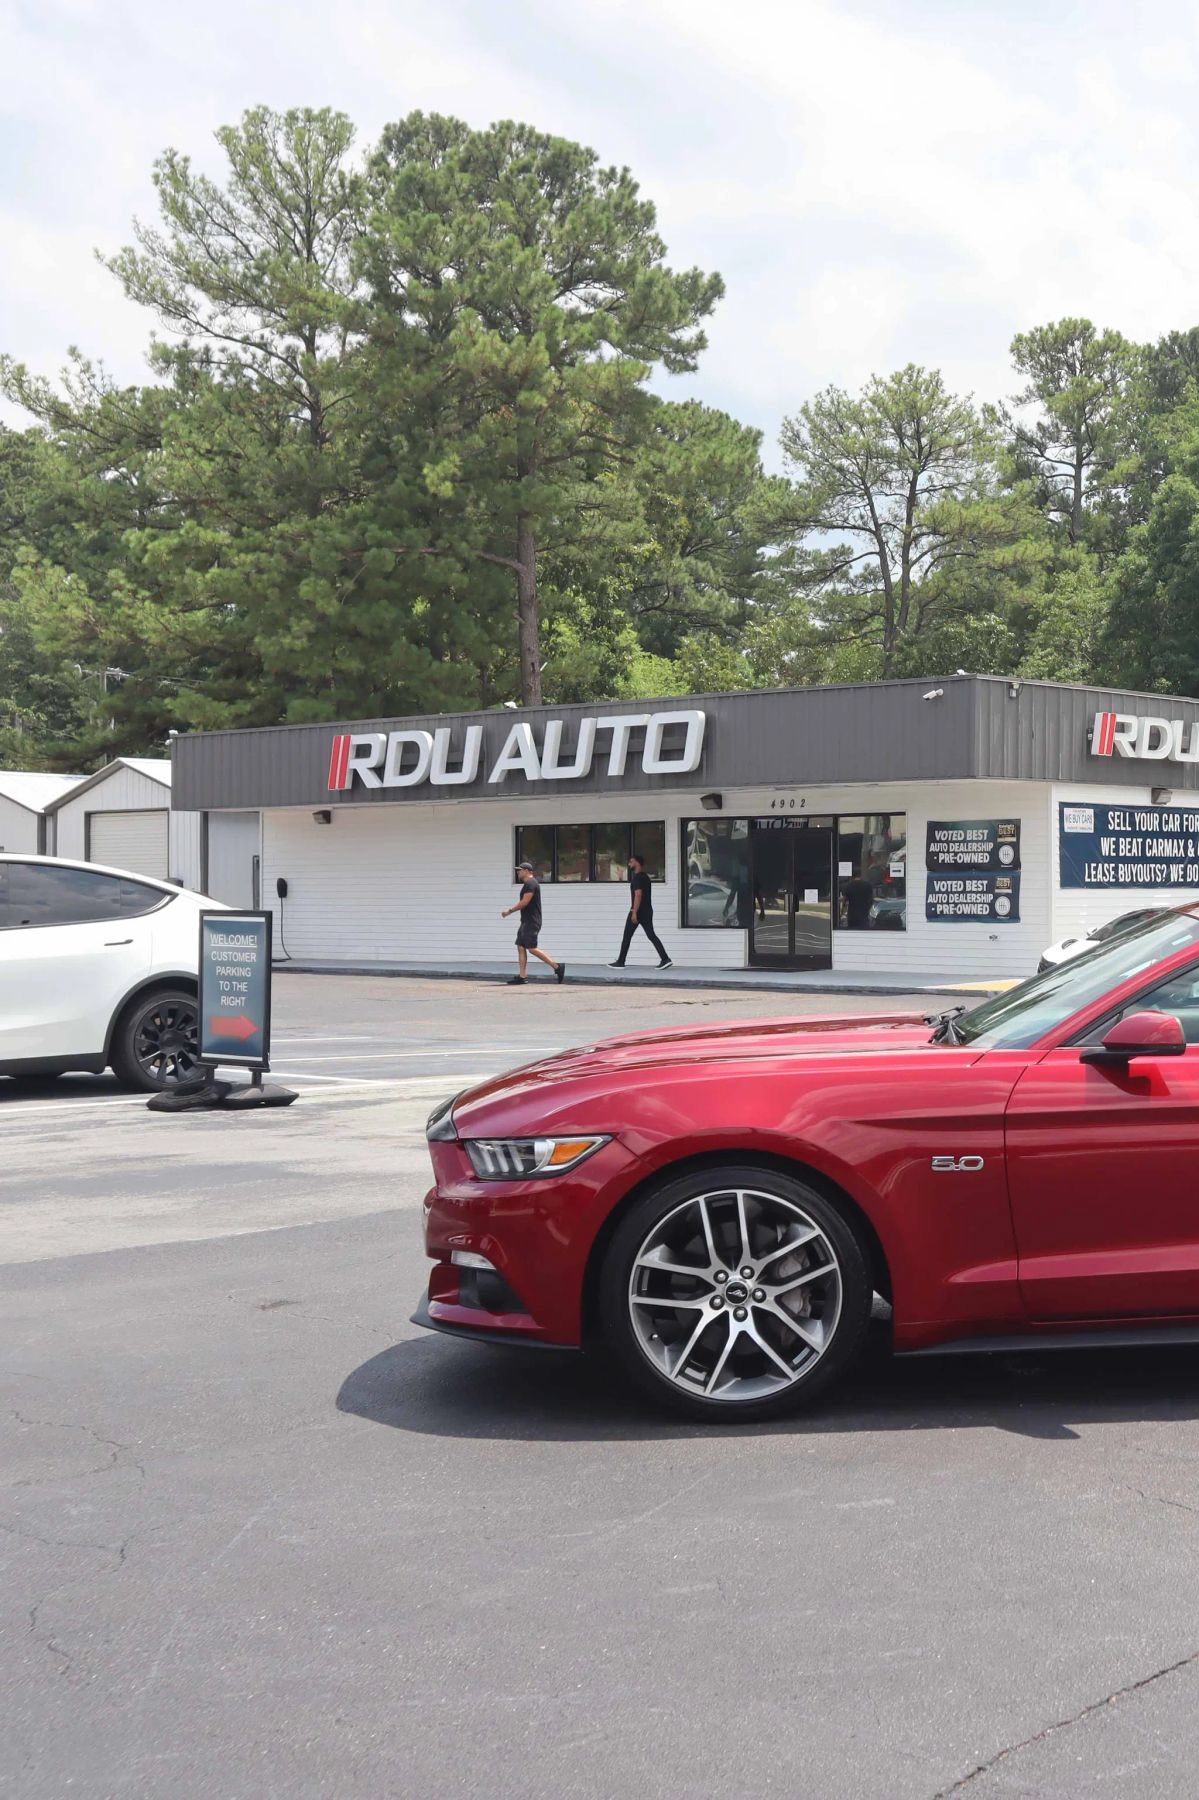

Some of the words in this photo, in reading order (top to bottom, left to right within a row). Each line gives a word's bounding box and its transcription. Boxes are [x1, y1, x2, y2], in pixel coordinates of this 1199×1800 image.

[327, 725, 483, 791] RDU
[487, 710, 706, 784] AUTO
[771, 798, 806, 809] 4902
[1107, 811, 1132, 832] SELL
[1134, 812, 1160, 832] YOUR
[1162, 813, 1181, 833] CAR
[935, 830, 964, 841] VOTED
[966, 829, 989, 840] BEST
[929, 842, 948, 852] AUTO
[949, 842, 994, 852] DEALERSHIP
[1101, 837, 1117, 857] WE
[1119, 838, 1143, 857] BEAT
[1145, 838, 1185, 858] CARMAX
[1187, 839, 1195, 858] &
[938, 852, 990, 863] PRE-OWNED
[1085, 863, 1116, 882] LEASE
[1118, 863, 1166, 882] BUYOUTS?
[1169, 864, 1184, 882] WE
[1186, 864, 1199, 882] DO
[933, 881, 964, 892] VOTED
[965, 880, 988, 892] BEST
[927, 893, 948, 903] AUTO
[949, 893, 994, 904] DEALERSHIP
[936, 904, 990, 915] PRE-OWNED
[210, 933, 257, 946] WELCOME!
[211, 951, 257, 963] CUSTOMER
[215, 966, 252, 977] PARKING
[219, 981, 231, 991] TO
[231, 981, 248, 992] THE
[220, 996, 246, 1007] RIGHT
[931, 1156, 984, 1171] 5.0
